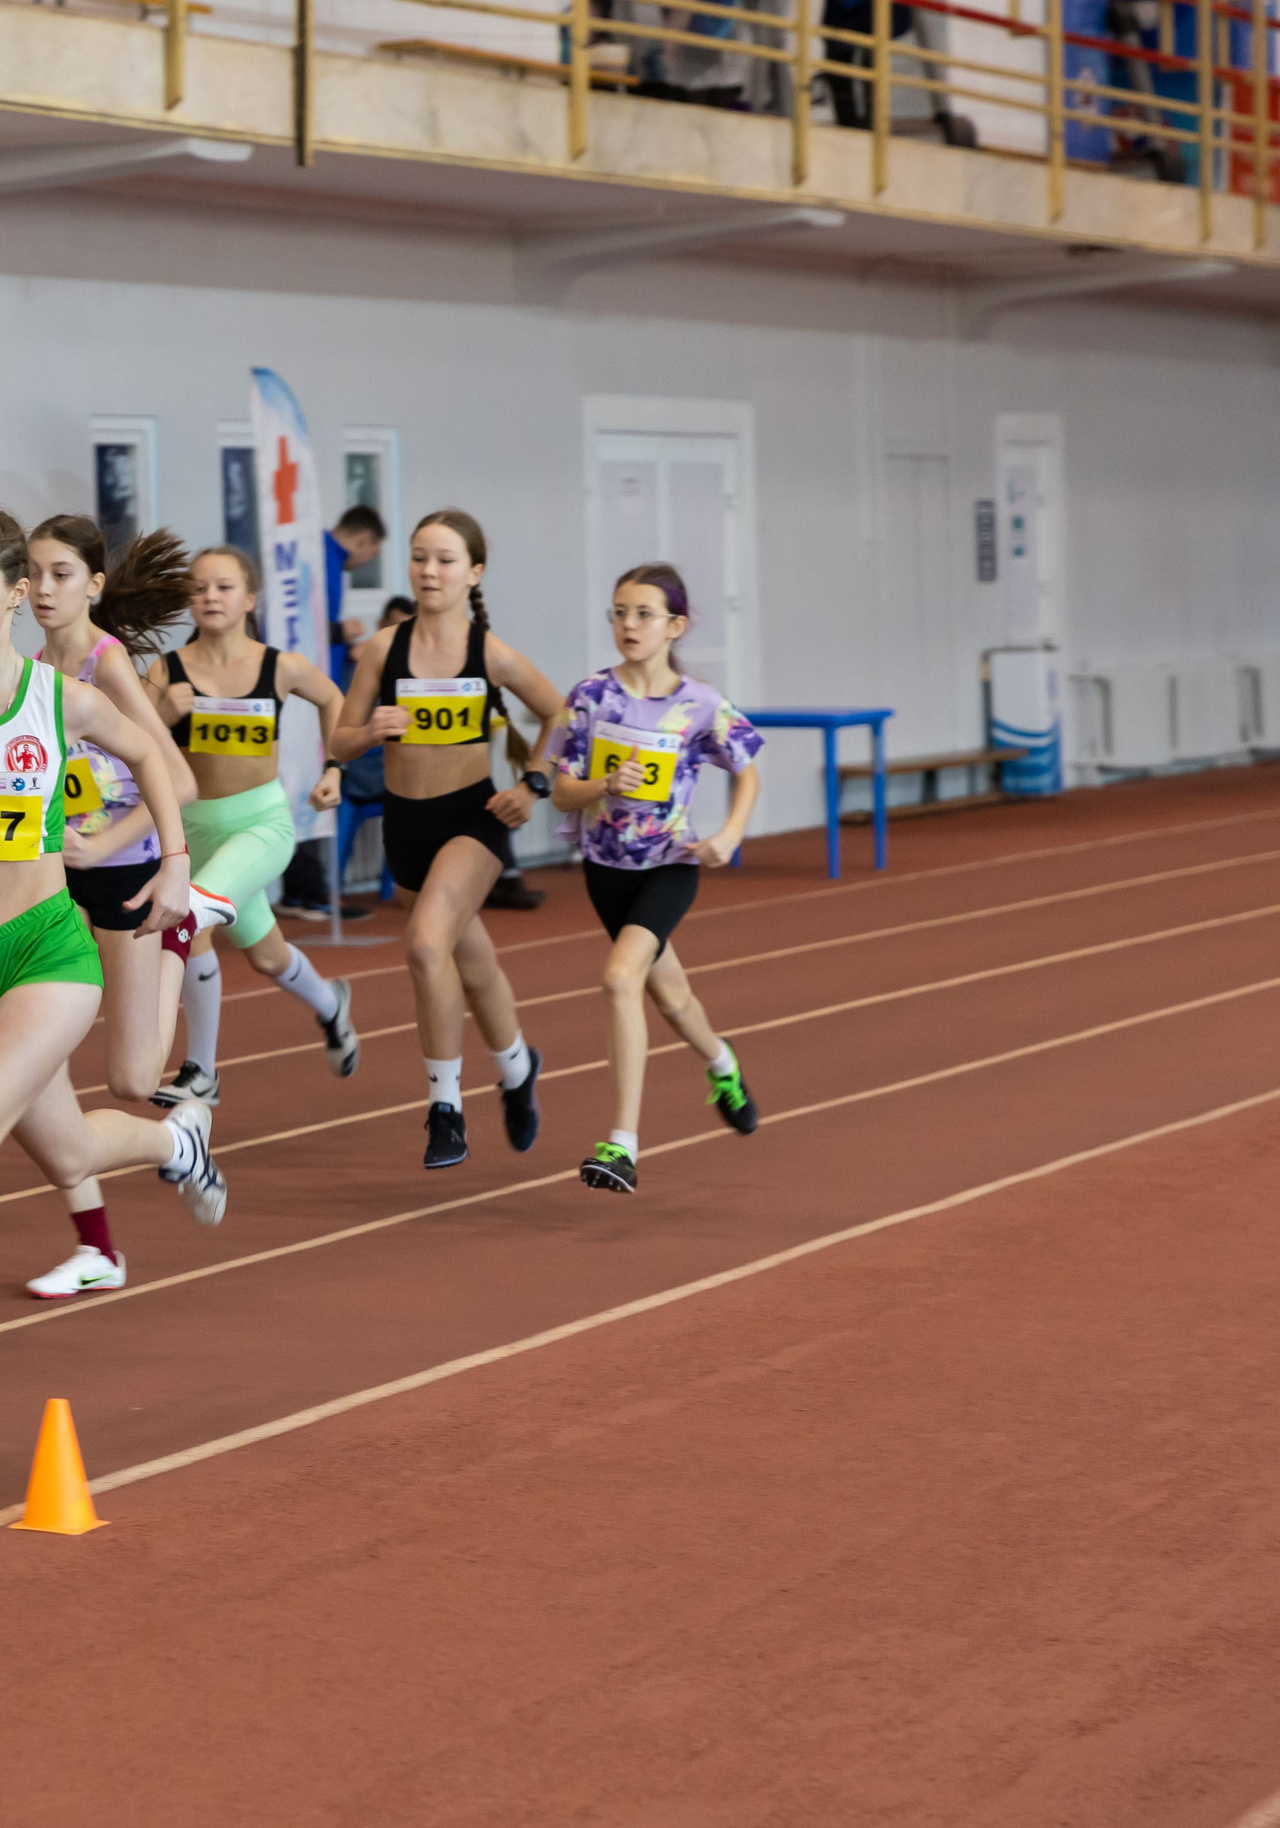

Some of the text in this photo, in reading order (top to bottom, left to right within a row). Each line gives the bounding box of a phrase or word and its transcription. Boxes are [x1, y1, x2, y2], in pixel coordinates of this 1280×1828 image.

[415, 706, 470, 731] 901
[196, 723, 269, 745] 1013
[605, 753, 660, 786] 63
